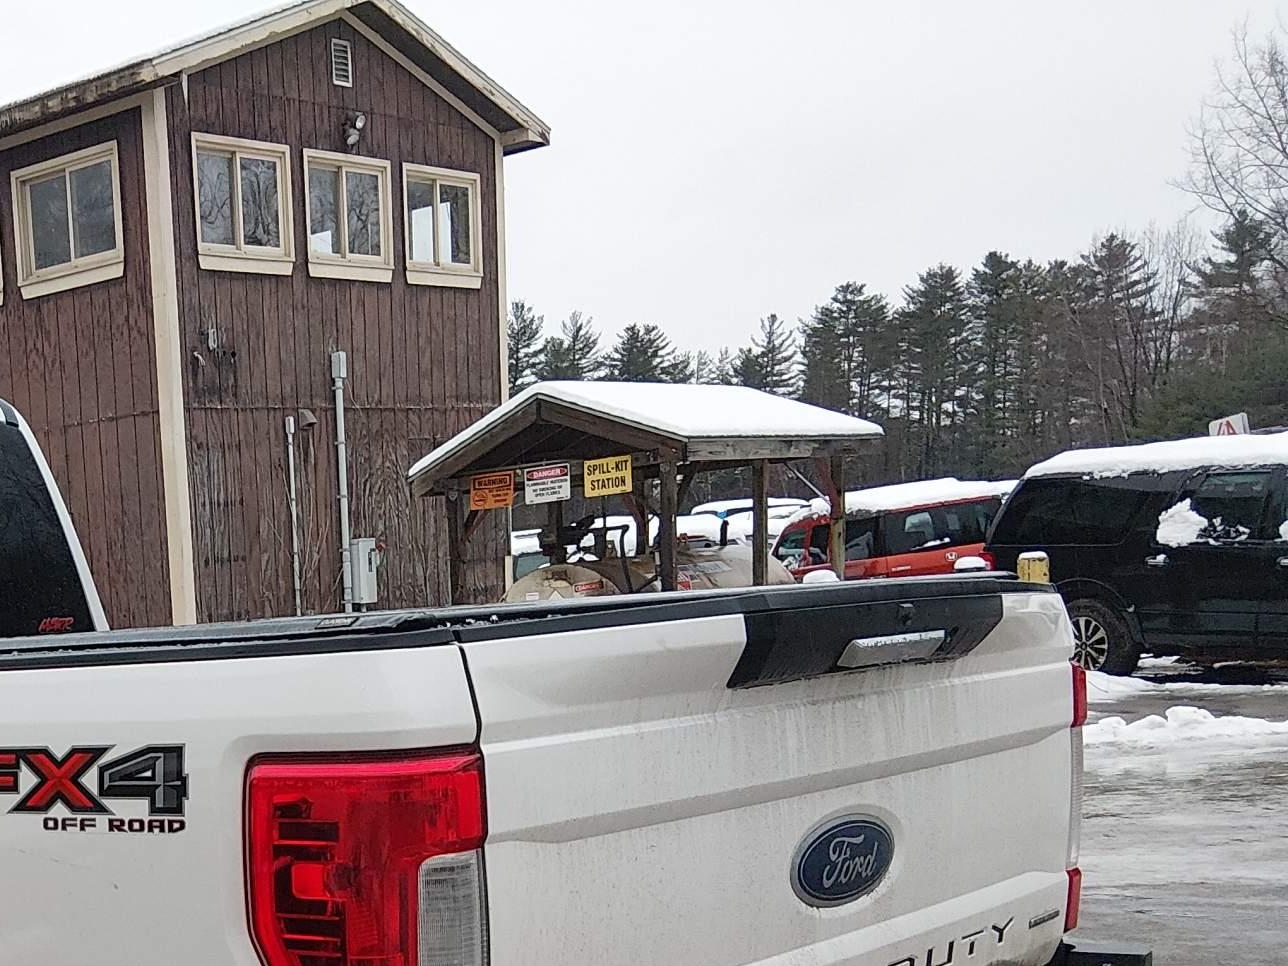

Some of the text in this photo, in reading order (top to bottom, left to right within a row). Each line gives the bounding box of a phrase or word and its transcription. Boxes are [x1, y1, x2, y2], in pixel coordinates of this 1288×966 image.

[532, 468, 561, 479] DANGER
[586, 460, 629, 476] SPILL-KIT
[477, 477, 508, 487] WARNING
[590, 476, 626, 491] STATION
[43, 816, 186, 834] OFF ROAD
[823, 834, 878, 888] Ford
